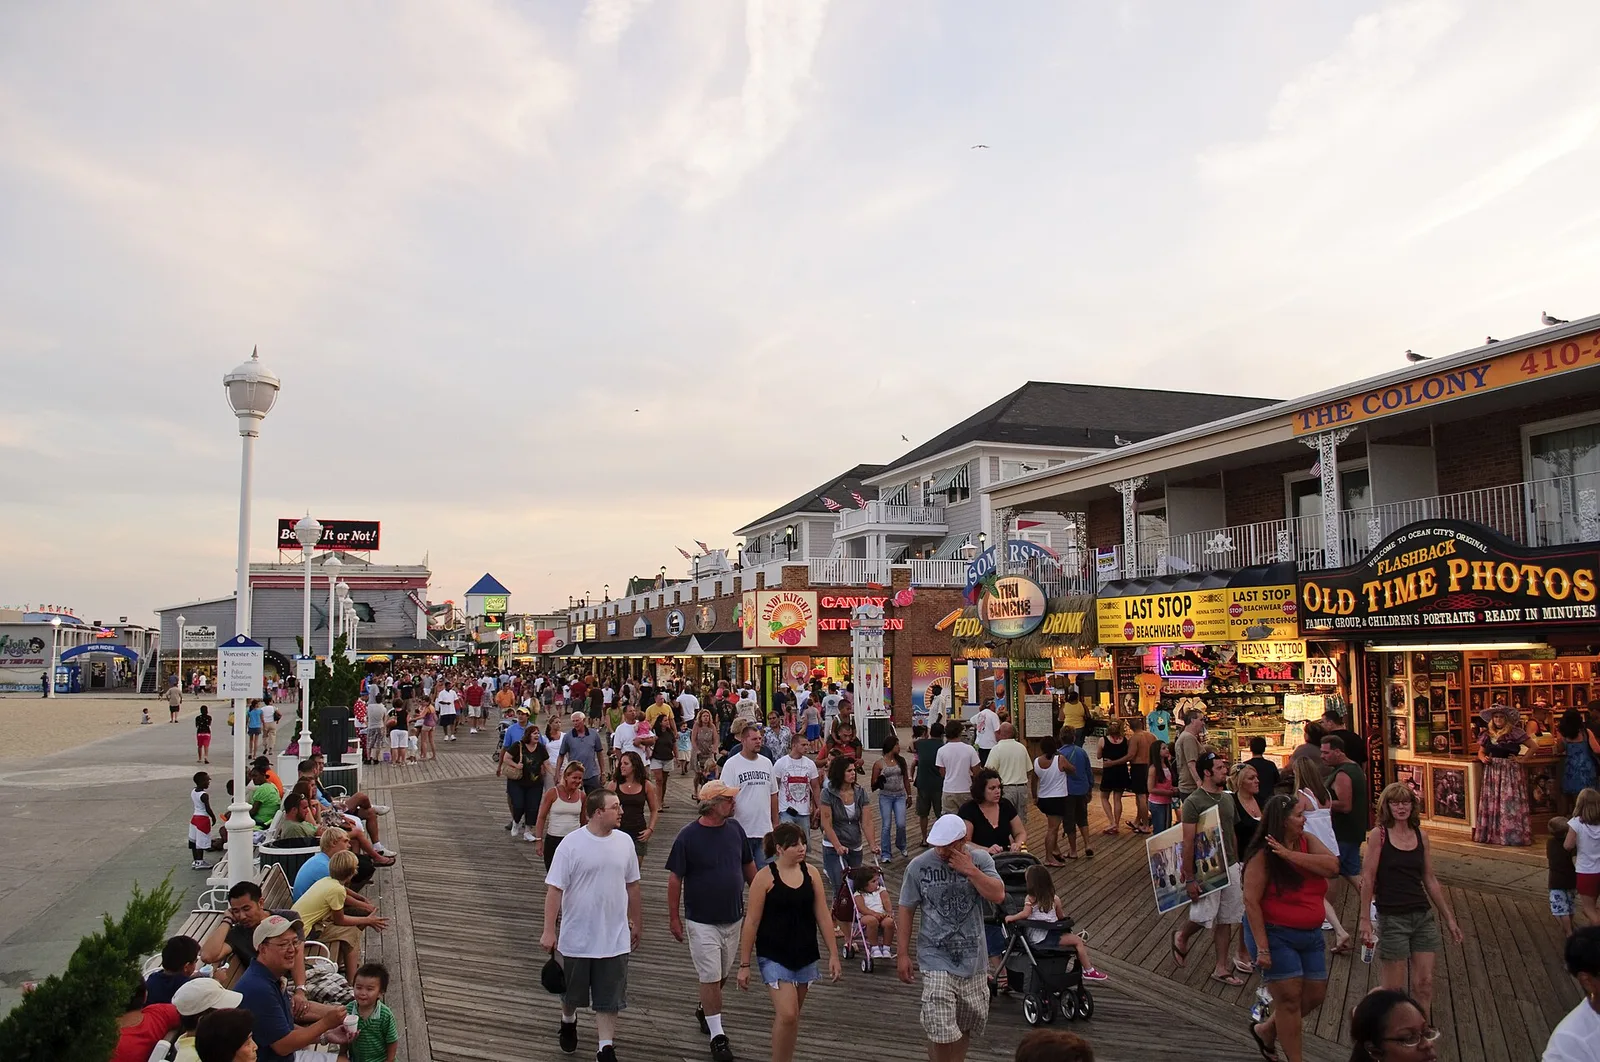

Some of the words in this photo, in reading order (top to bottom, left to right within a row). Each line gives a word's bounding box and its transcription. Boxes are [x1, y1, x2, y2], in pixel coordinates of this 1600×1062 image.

[1298, 401, 1353, 430] THE
[1362, 364, 1492, 415] COLONY
[323, 530, 334, 540] It
[337, 533, 350, 541] or
[351, 531, 377, 541] Not!
[1367, 541, 1397, 568] WELCOME
[1397, 536, 1407, 544] TO
[1408, 528, 1431, 540] OCEAN
[1433, 528, 1455, 537] CITY'S
[1455, 533, 1488, 554] ORIGINAL
[1377, 539, 1457, 576] FLASHBACK
[998, 582, 1019, 600] TIKI
[1233, 591, 1258, 602] LAST
[1262, 589, 1291, 601] STOP
[1303, 582, 1356, 615] OLD
[1362, 567, 1438, 612] TIME
[1447, 558, 1597, 602] PHOTOS
[762, 594, 783, 621] CANDY
[783, 592, 813, 621] KITCHEN
[821, 596, 888, 609] CANDY
[1125, 598, 1153, 620] LAST
[1158, 595, 1192, 618] STOP
[1243, 604, 1281, 612] BEACHWEAR
[952, 617, 983, 637] FOOD
[1042, 611, 1085, 635] DRINK
[1305, 618, 1334, 630] FAMILY,
[1334, 617, 1361, 628] GROUP,
[1368, 614, 1420, 627] CHILDREN'S
[1423, 611, 1476, 625] PORTRAITS
[1485, 610, 1520, 623] READY
[1525, 607, 1538, 620] IN
[1542, 605, 1597, 619] MINUTES
[1136, 624, 1182, 638] BEACHWEAR
[1182, 625, 1195, 633] STOP
[1241, 643, 1270, 655] HENNA
[1274, 642, 1303, 654] TATTOO
[738, 770, 771, 784] REHOBOTH
